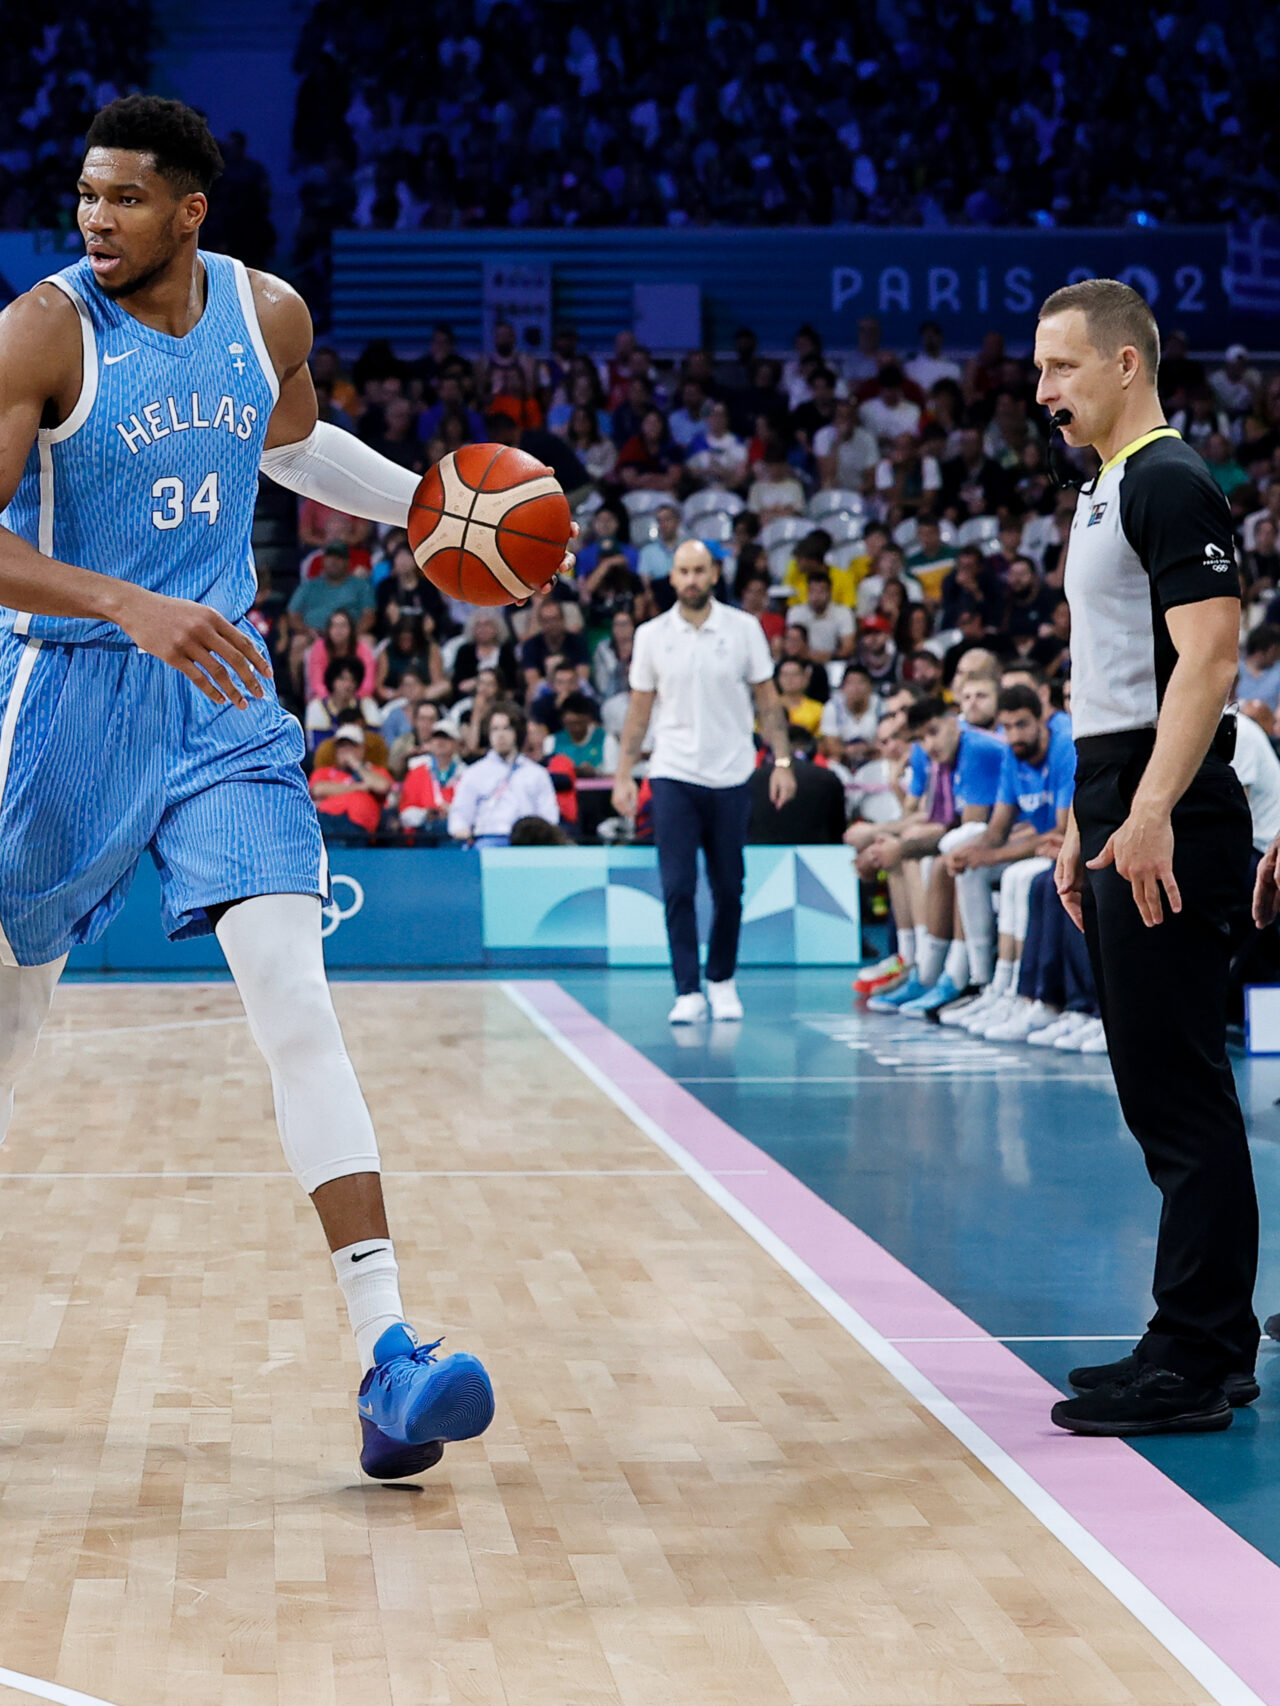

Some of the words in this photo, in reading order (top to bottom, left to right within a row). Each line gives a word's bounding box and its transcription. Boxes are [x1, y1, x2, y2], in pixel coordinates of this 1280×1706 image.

[831, 265, 1034, 312] PARIS
[116, 391, 258, 456] HELLAS
[151, 471, 220, 531] 34
